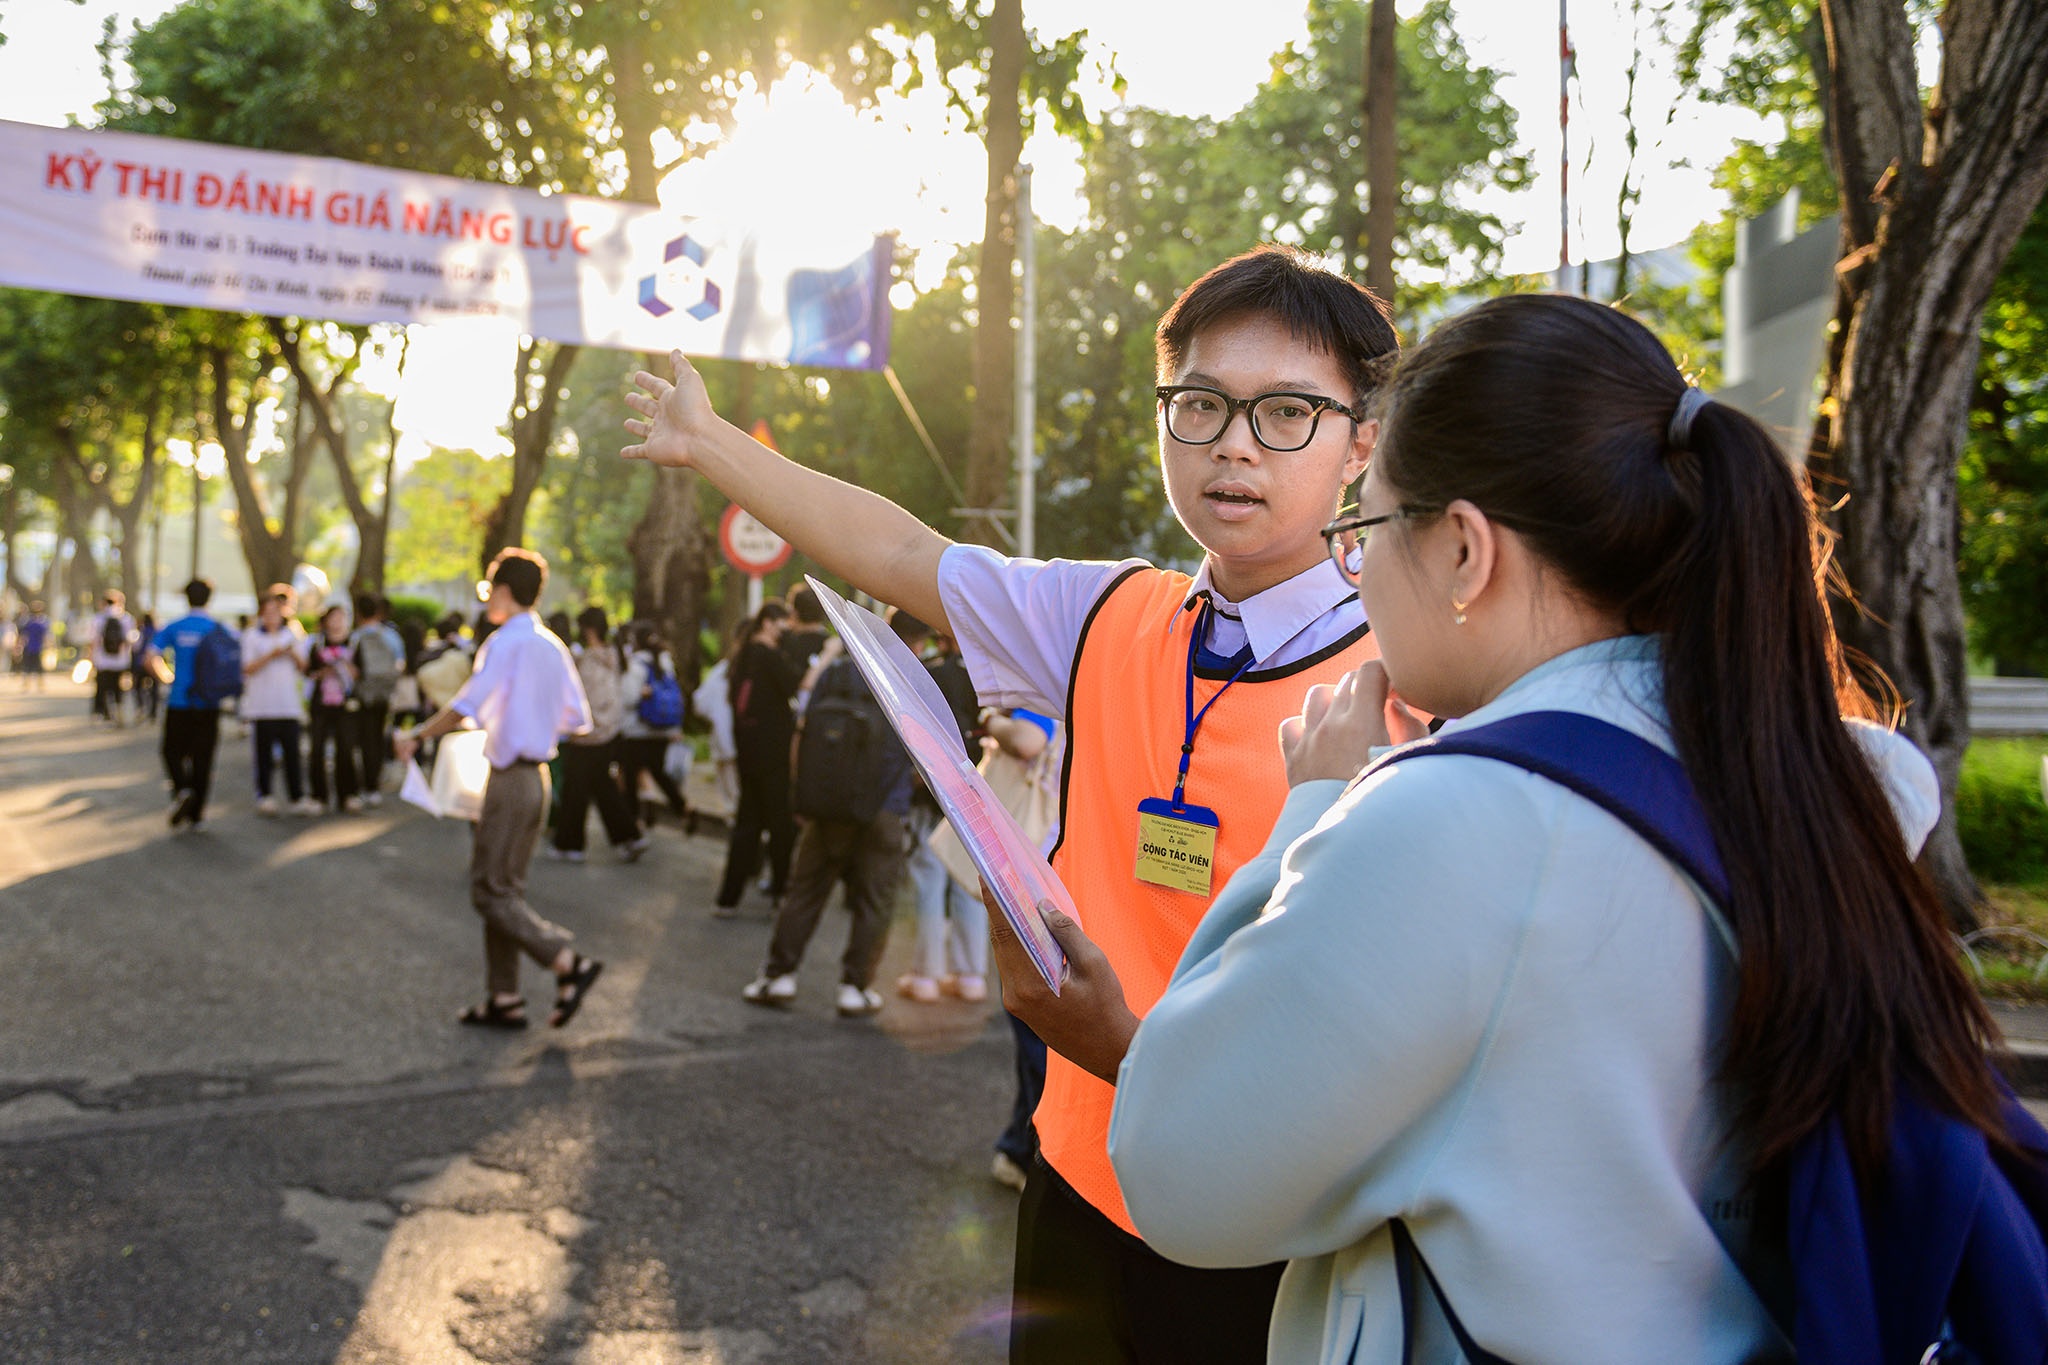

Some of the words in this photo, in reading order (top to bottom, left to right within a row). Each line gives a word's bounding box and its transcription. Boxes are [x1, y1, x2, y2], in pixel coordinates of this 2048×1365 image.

[113, 160, 185, 204] THI
[194, 170, 316, 221] ĐÁNH
[324, 187, 392, 231] GIÁ
[402, 194, 513, 246] NĂNG
[521, 214, 592, 262] LỰC
[1143, 842, 1167, 857] CỘNG
[1169, 848, 1187, 862] TÁC
[1188, 853, 1210, 868] VIÊN
